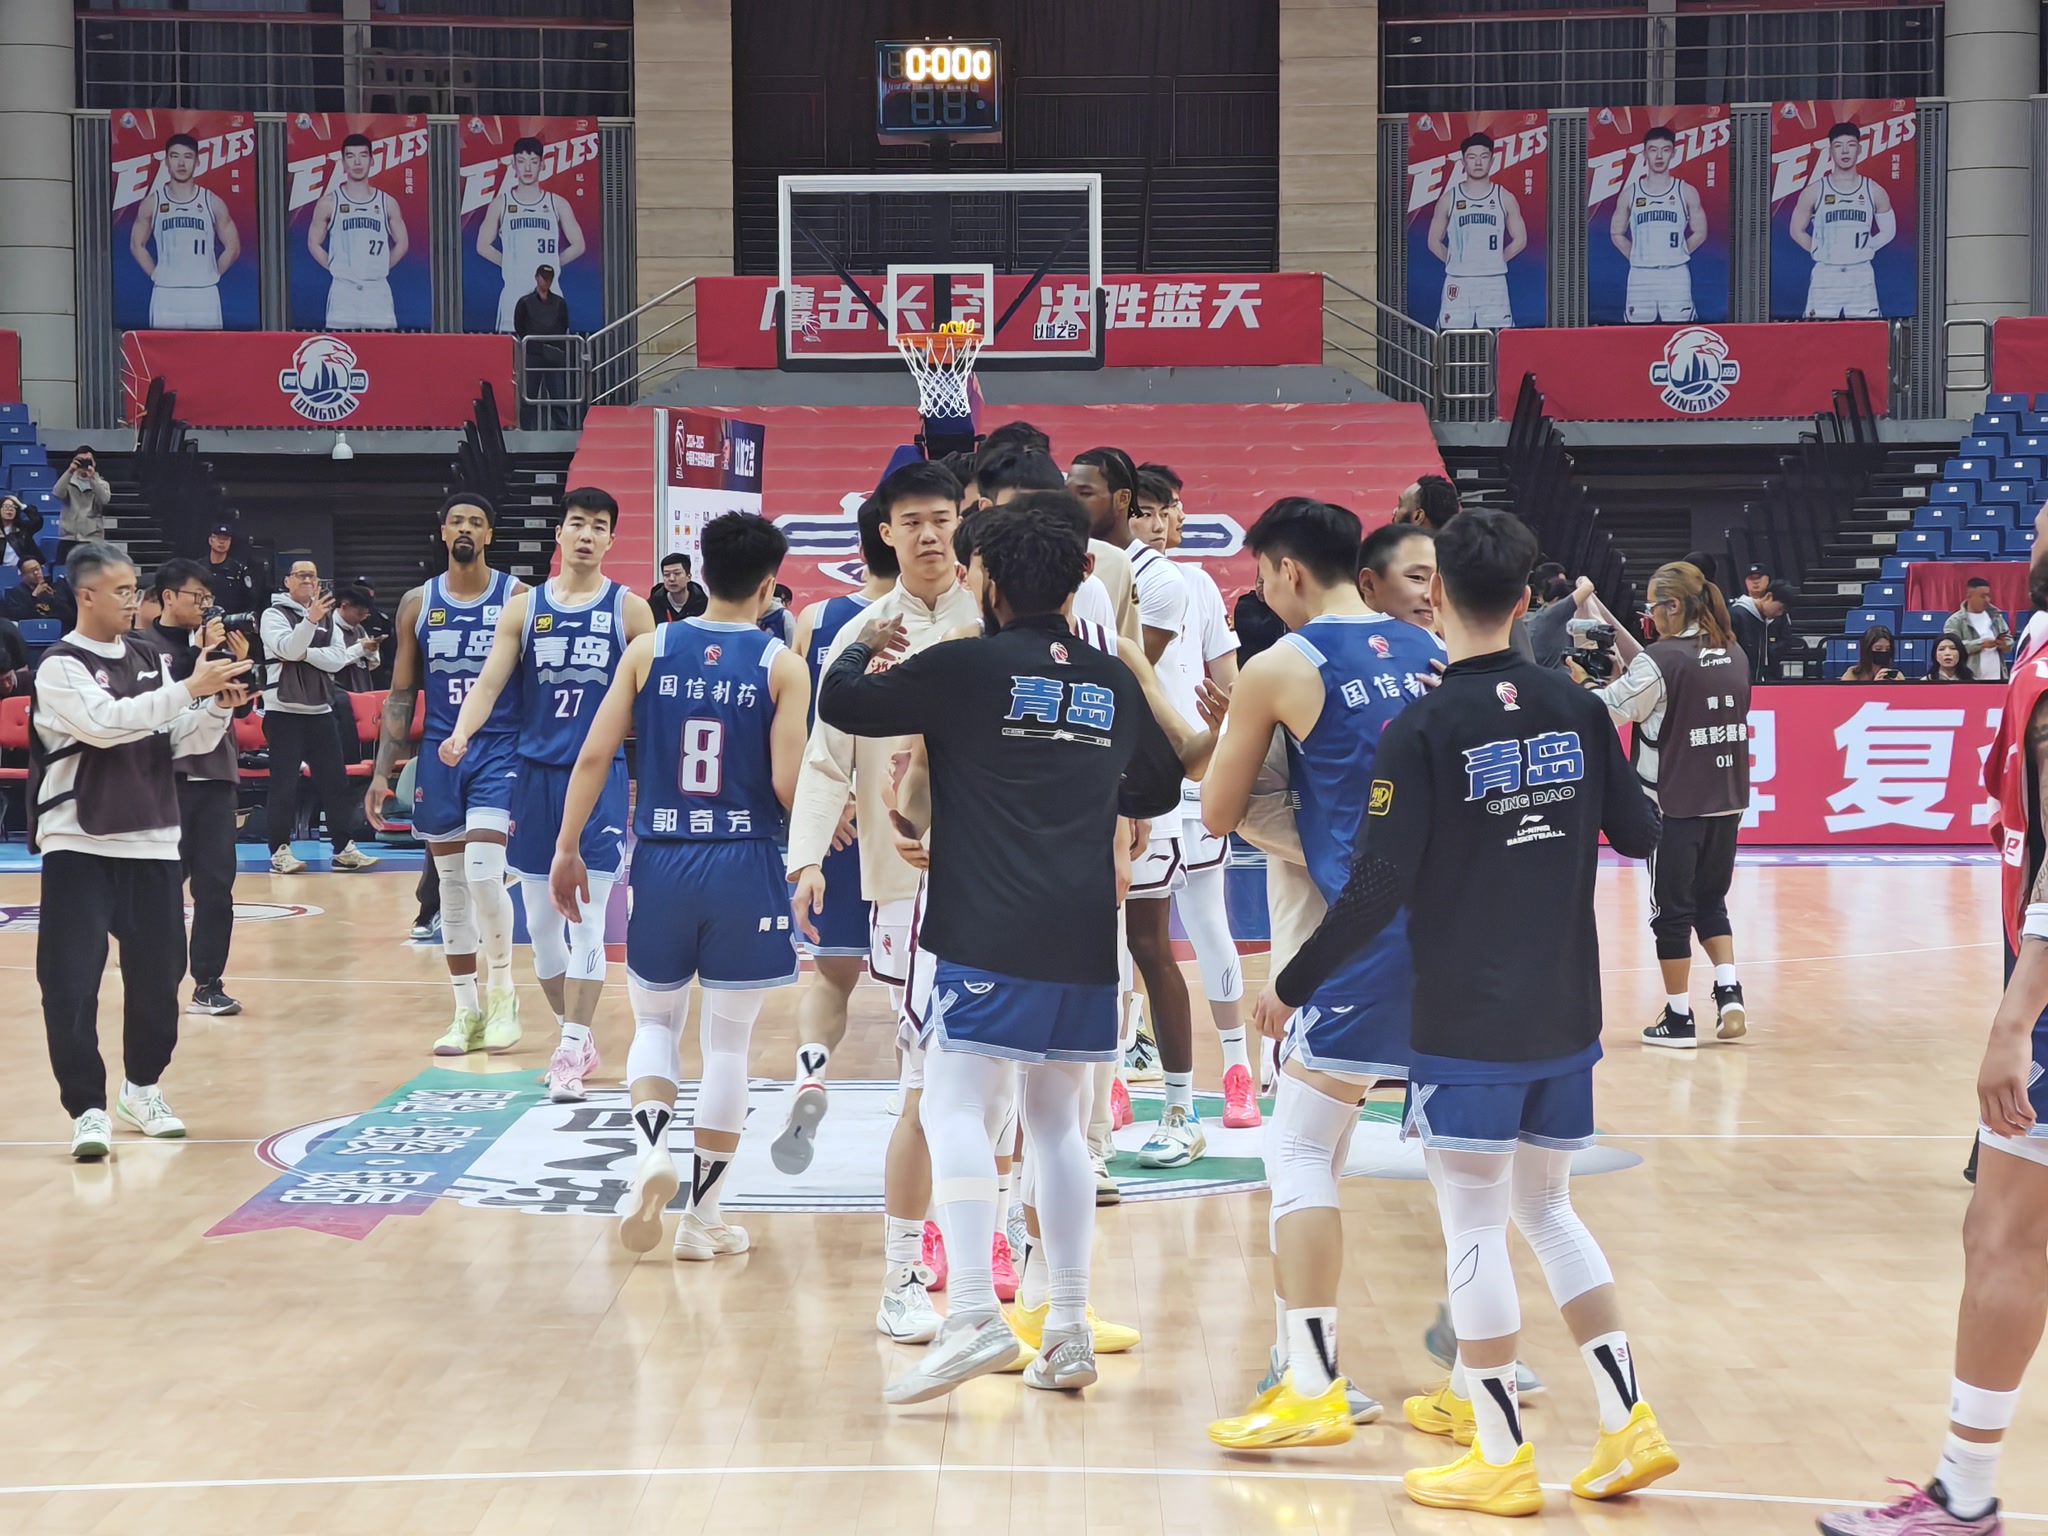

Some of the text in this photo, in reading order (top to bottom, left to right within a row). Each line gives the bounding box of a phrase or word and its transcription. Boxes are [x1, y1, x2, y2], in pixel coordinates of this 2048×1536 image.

[194, 239, 205, 255] 11
[369, 239, 384, 256] 27
[537, 239, 555, 254] 36
[1489, 234, 1497, 250] 8
[1670, 232, 1679, 248] 9
[1855, 231, 1869, 249] 17
[1037, 283, 1262, 329] 决胜篮天
[294, 397, 356, 420] QINGDAO
[1664, 388, 1727, 412] QINGDAO
[427, 629, 496, 659] 青岛
[533, 635, 611, 668] 青岛
[554, 689, 584, 718] 27
[658, 674, 758, 708] 国信制药
[1003, 676, 1115, 730] 青岛
[1340, 672, 1442, 709] 国信制
[679, 717, 724, 796] 8
[1462, 732, 1584, 801] 青岛
[1486, 786, 1575, 815] QING DAO
[652, 808, 752, 833] 郭奇芳
[1506, 830, 1566, 846] BASKETBALL
